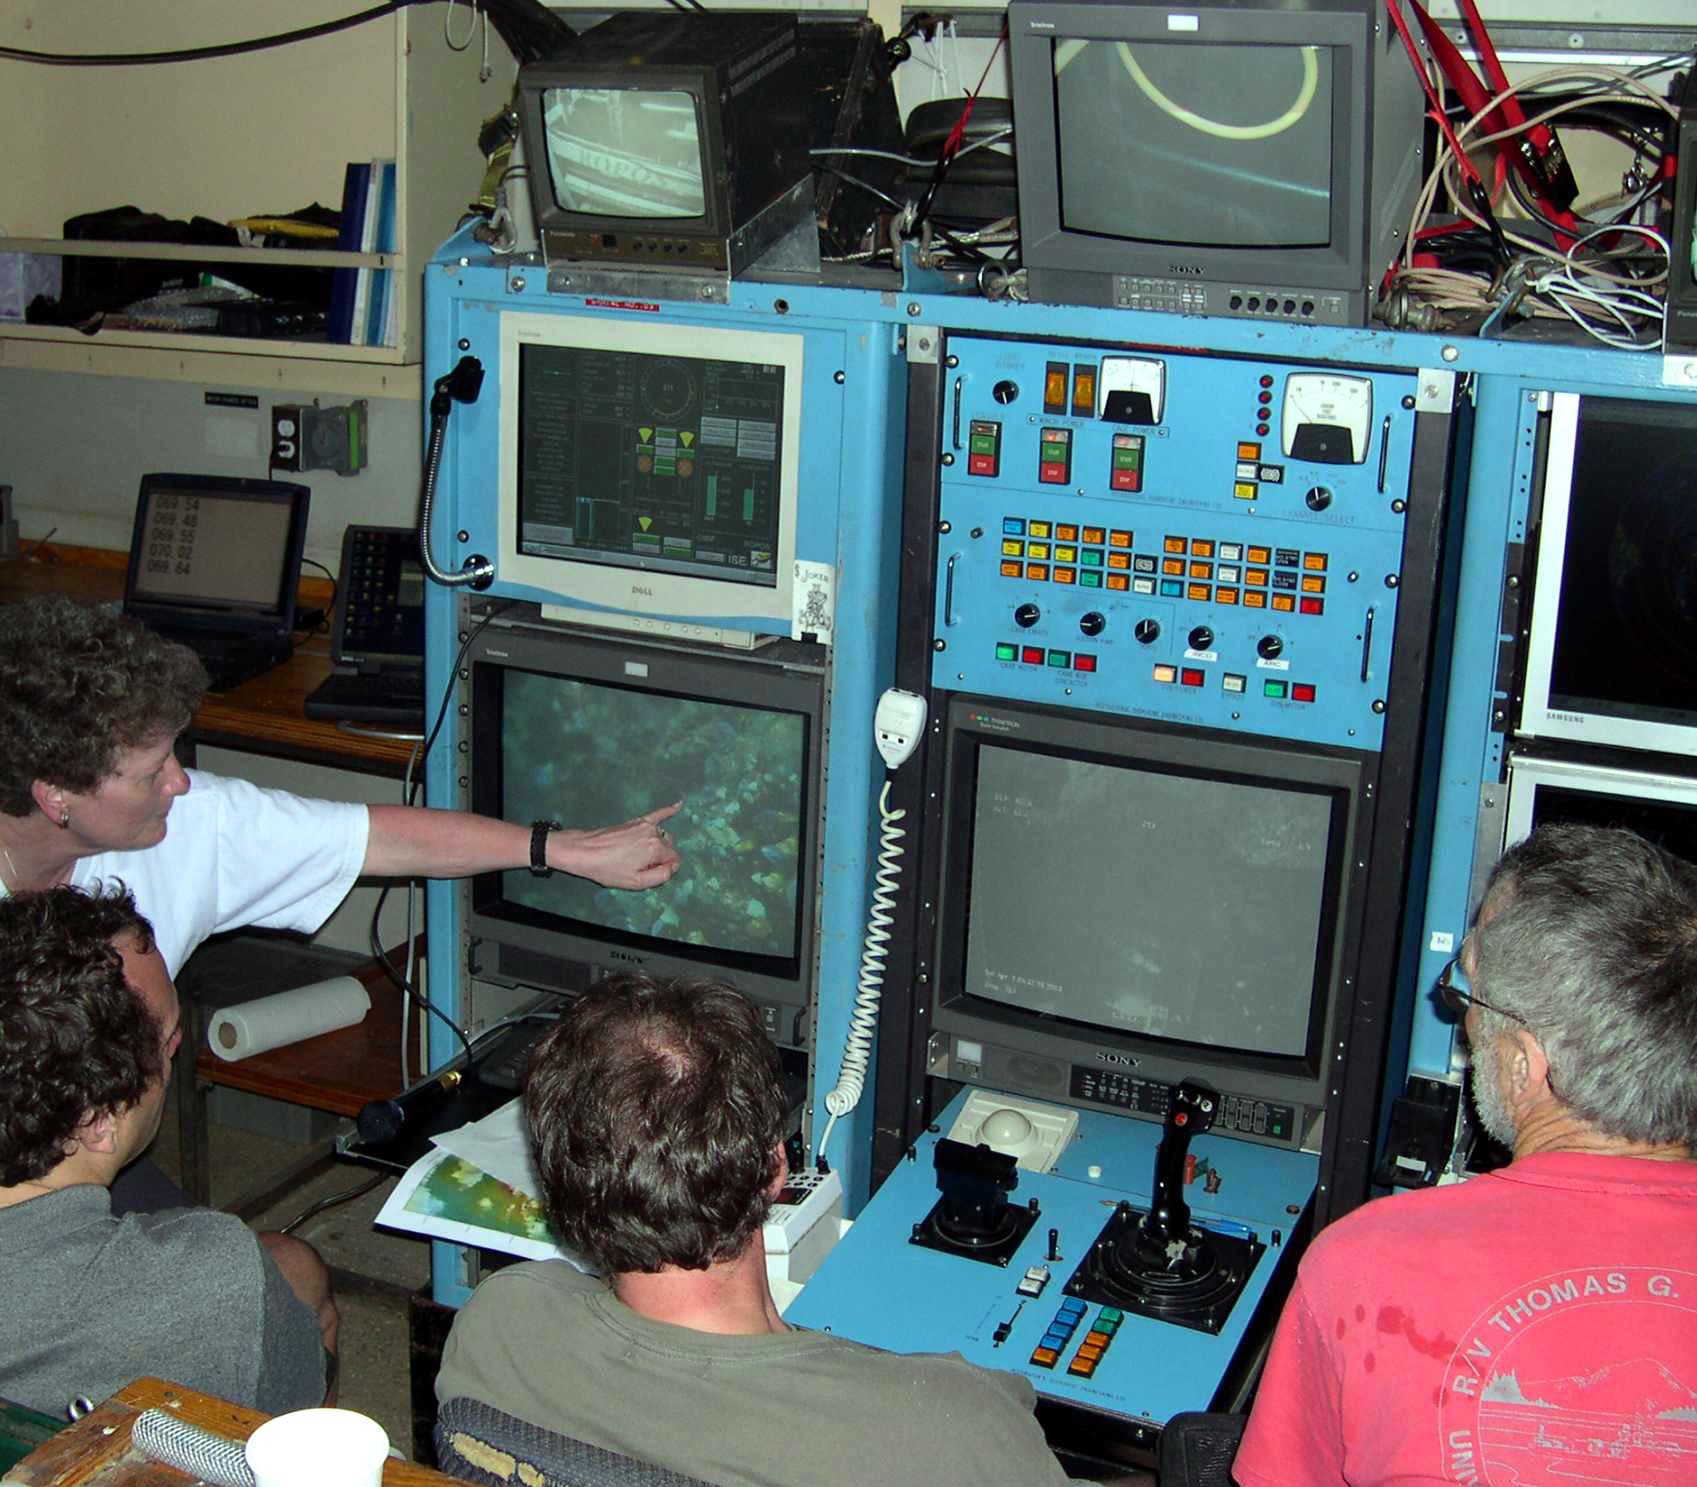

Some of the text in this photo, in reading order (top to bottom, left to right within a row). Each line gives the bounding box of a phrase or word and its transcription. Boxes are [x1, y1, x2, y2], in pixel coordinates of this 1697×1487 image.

[1546, 711, 1585, 724] SAMSUNG
[1095, 1050, 1143, 1068] SONY
[1452, 1271, 1680, 1396] R/V THOMAS G.
